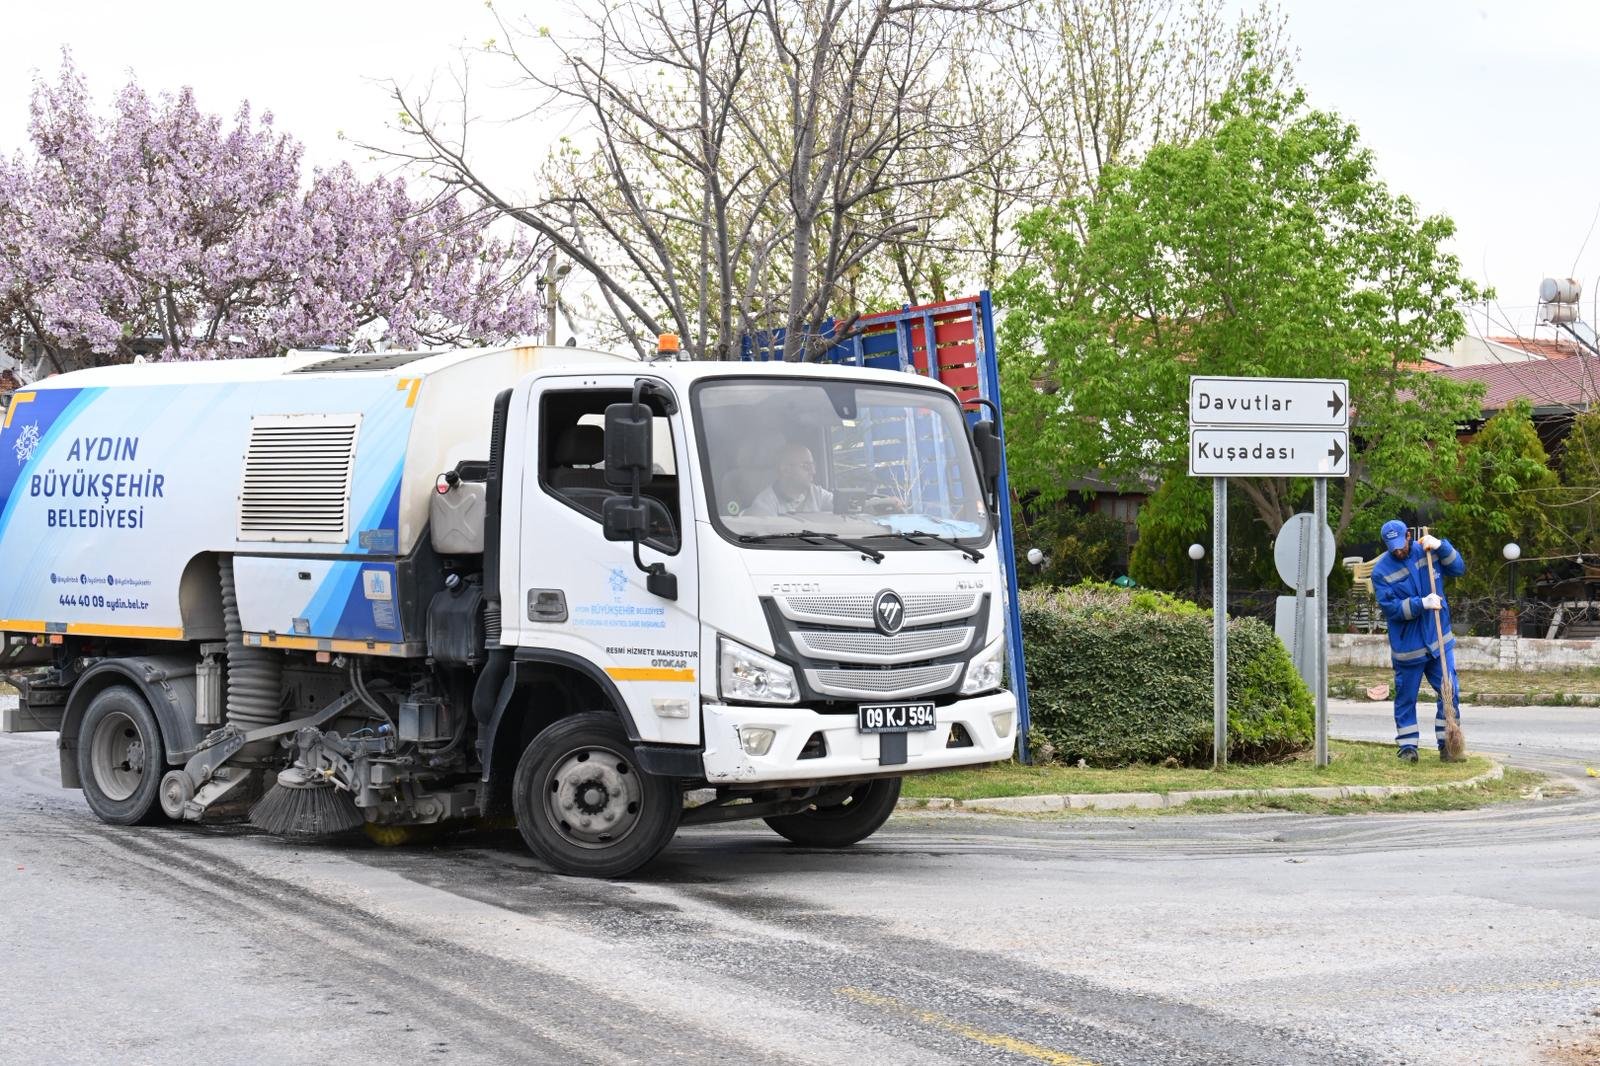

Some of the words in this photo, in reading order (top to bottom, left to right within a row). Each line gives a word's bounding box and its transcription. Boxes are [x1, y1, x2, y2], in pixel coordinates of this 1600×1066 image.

[1199, 392, 1292, 412] Davutlar
[67, 437, 139, 461] AYDIN
[1198, 442, 1295, 461] Kuşadası
[30, 468, 165, 504] BÜYÜKŞEHİR
[47, 505, 143, 529] BELEDİYESİ
[60, 594, 76, 607] 444
[78, 595, 90, 607] 40
[92, 595, 104, 608] 09
[606, 646, 625, 655] RESMİ
[626, 647, 655, 656] HİZMETE
[656, 649, 698, 658] MAHSUSTUR
[651, 658, 687, 668] OTOKAR
[866, 708, 883, 728] 09
[886, 707, 906, 727] KJ
[909, 706, 933, 726] 594
